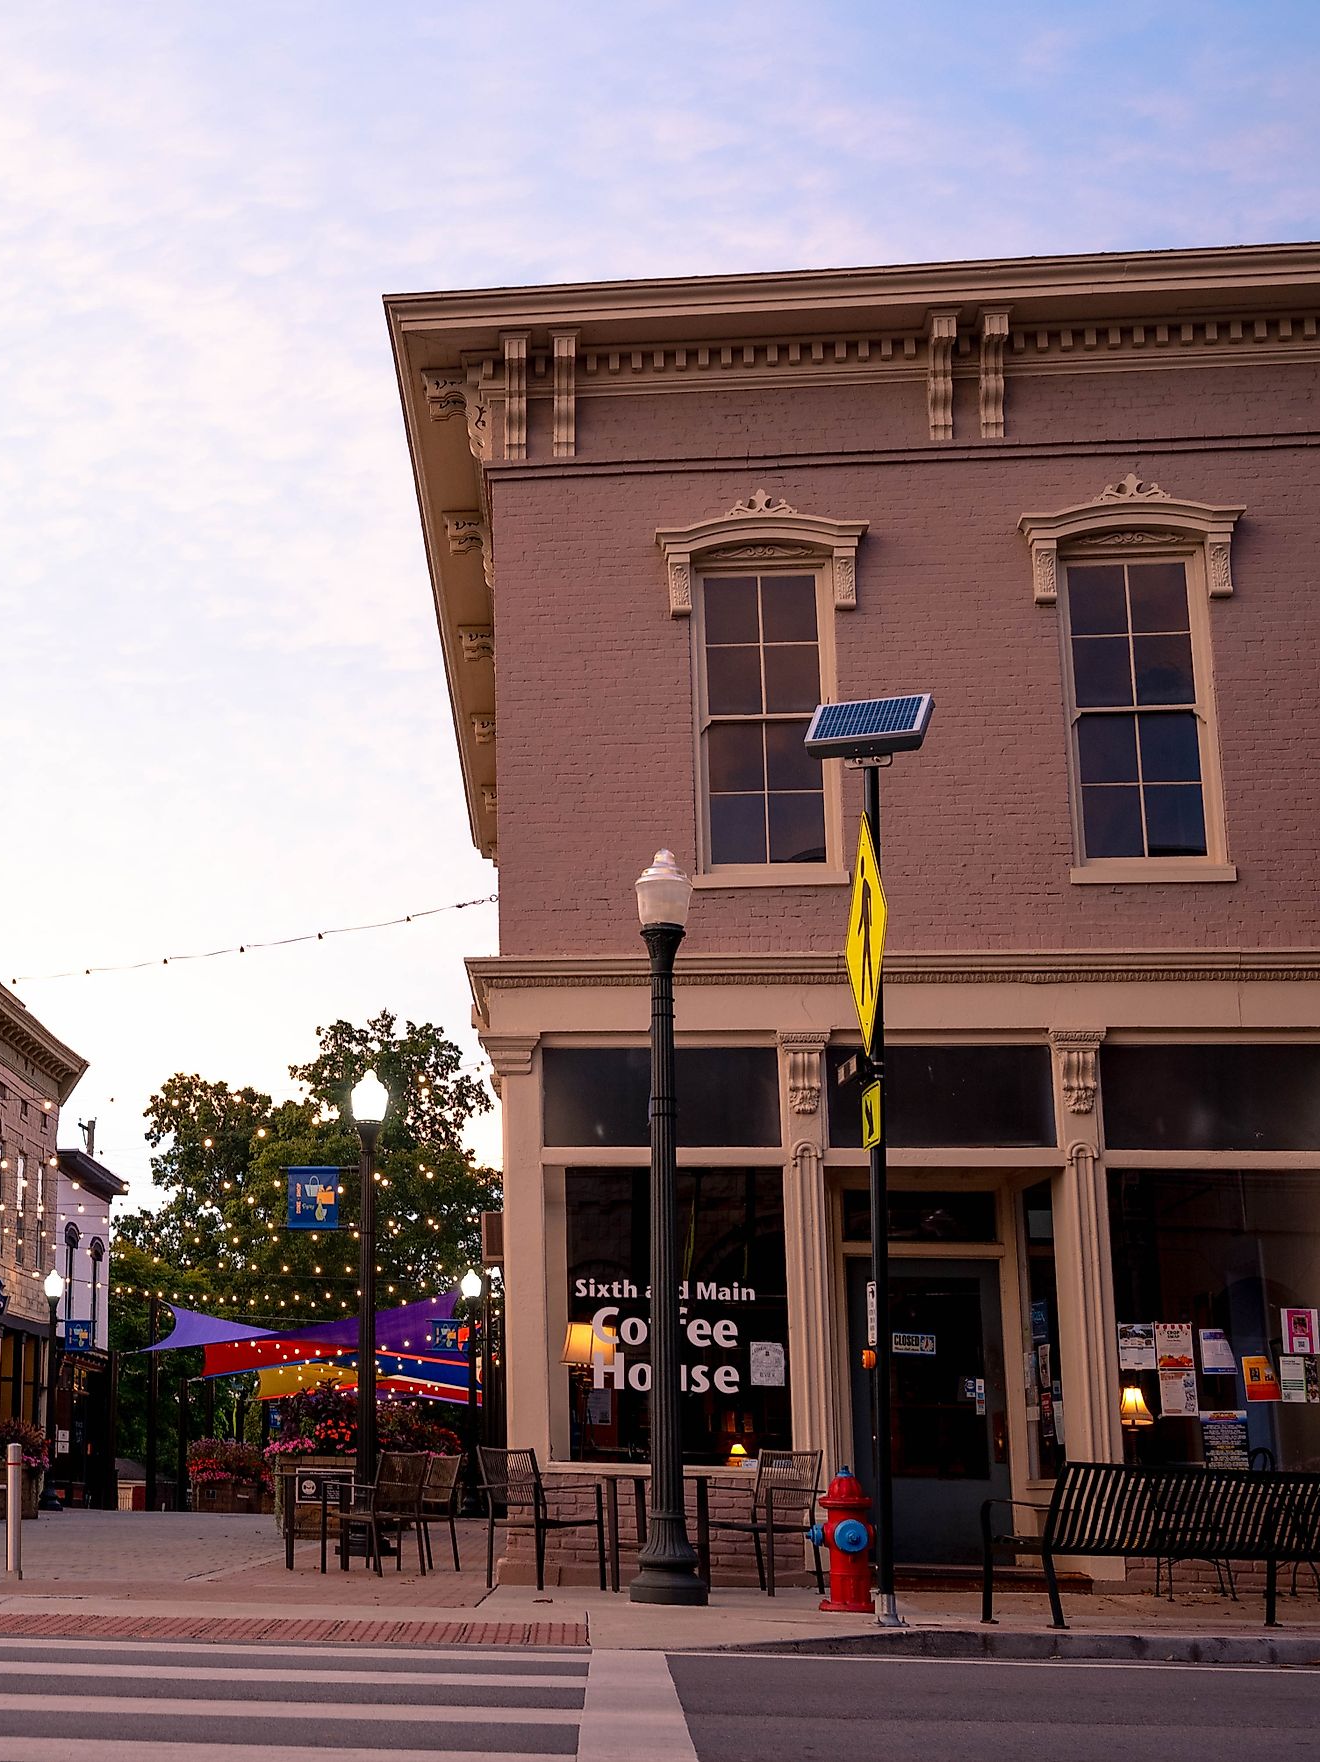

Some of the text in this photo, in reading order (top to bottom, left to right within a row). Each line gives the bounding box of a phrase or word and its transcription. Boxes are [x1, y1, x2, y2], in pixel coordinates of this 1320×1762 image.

[575, 1278, 756, 1301] Sixth ad Main
[592, 1306, 738, 1347] Coee
[894, 1335, 920, 1346] CLOSED
